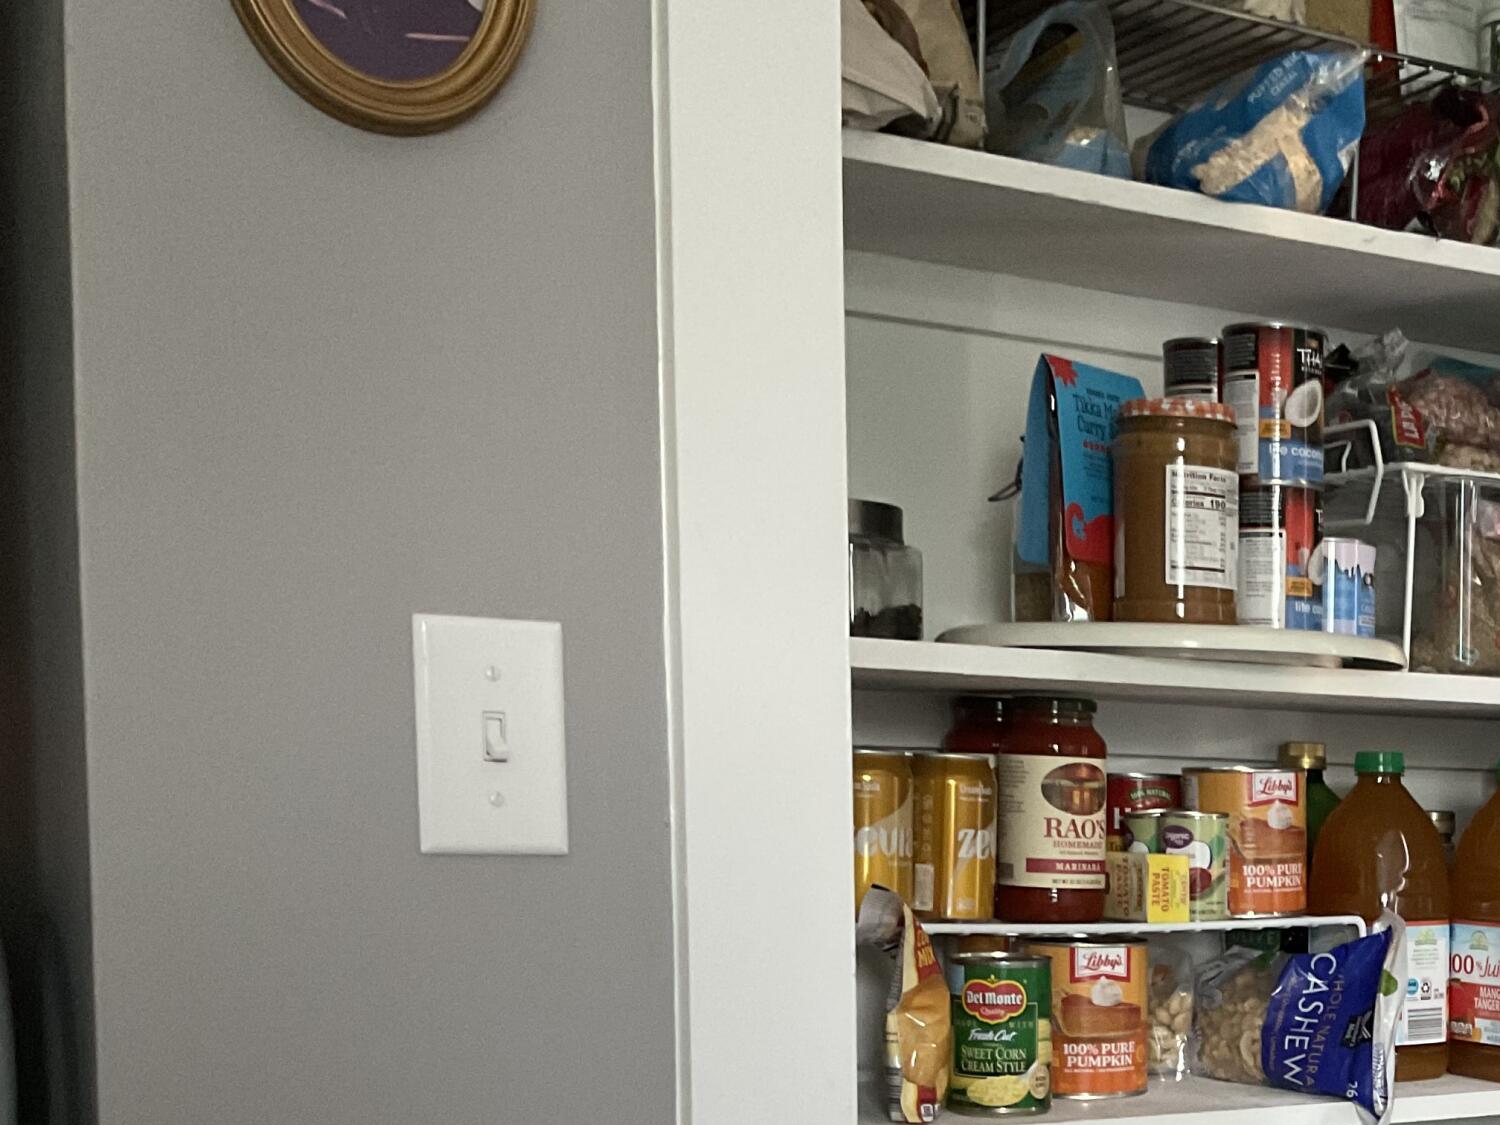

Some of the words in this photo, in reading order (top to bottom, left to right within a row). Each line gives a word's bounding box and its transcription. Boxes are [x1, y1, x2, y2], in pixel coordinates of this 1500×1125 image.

[1210, 499, 1226, 509] 190
[1259, 776, 1292, 796] Libby's
[1243, 864, 1275, 877] 100%
[1151, 872, 1161, 906] PASTE
[1160, 866, 1170, 912] TOMATO
[1083, 951, 1123, 971] Libby's
[966, 991, 983, 1004] Del
[985, 992, 1023, 1005] Monte
[1283, 952, 1338, 1086] CASHEW
[961, 1044, 994, 1060] SWEET
[995, 1046, 1027, 1060] CORN
[1063, 1043, 1099, 1056] 100%
[1101, 1041, 1136, 1055] PURE
[961, 1060, 994, 1073] CREAM
[996, 1060, 1027, 1073] STYLE
[1067, 1054, 1133, 1068] PUMPKIN
